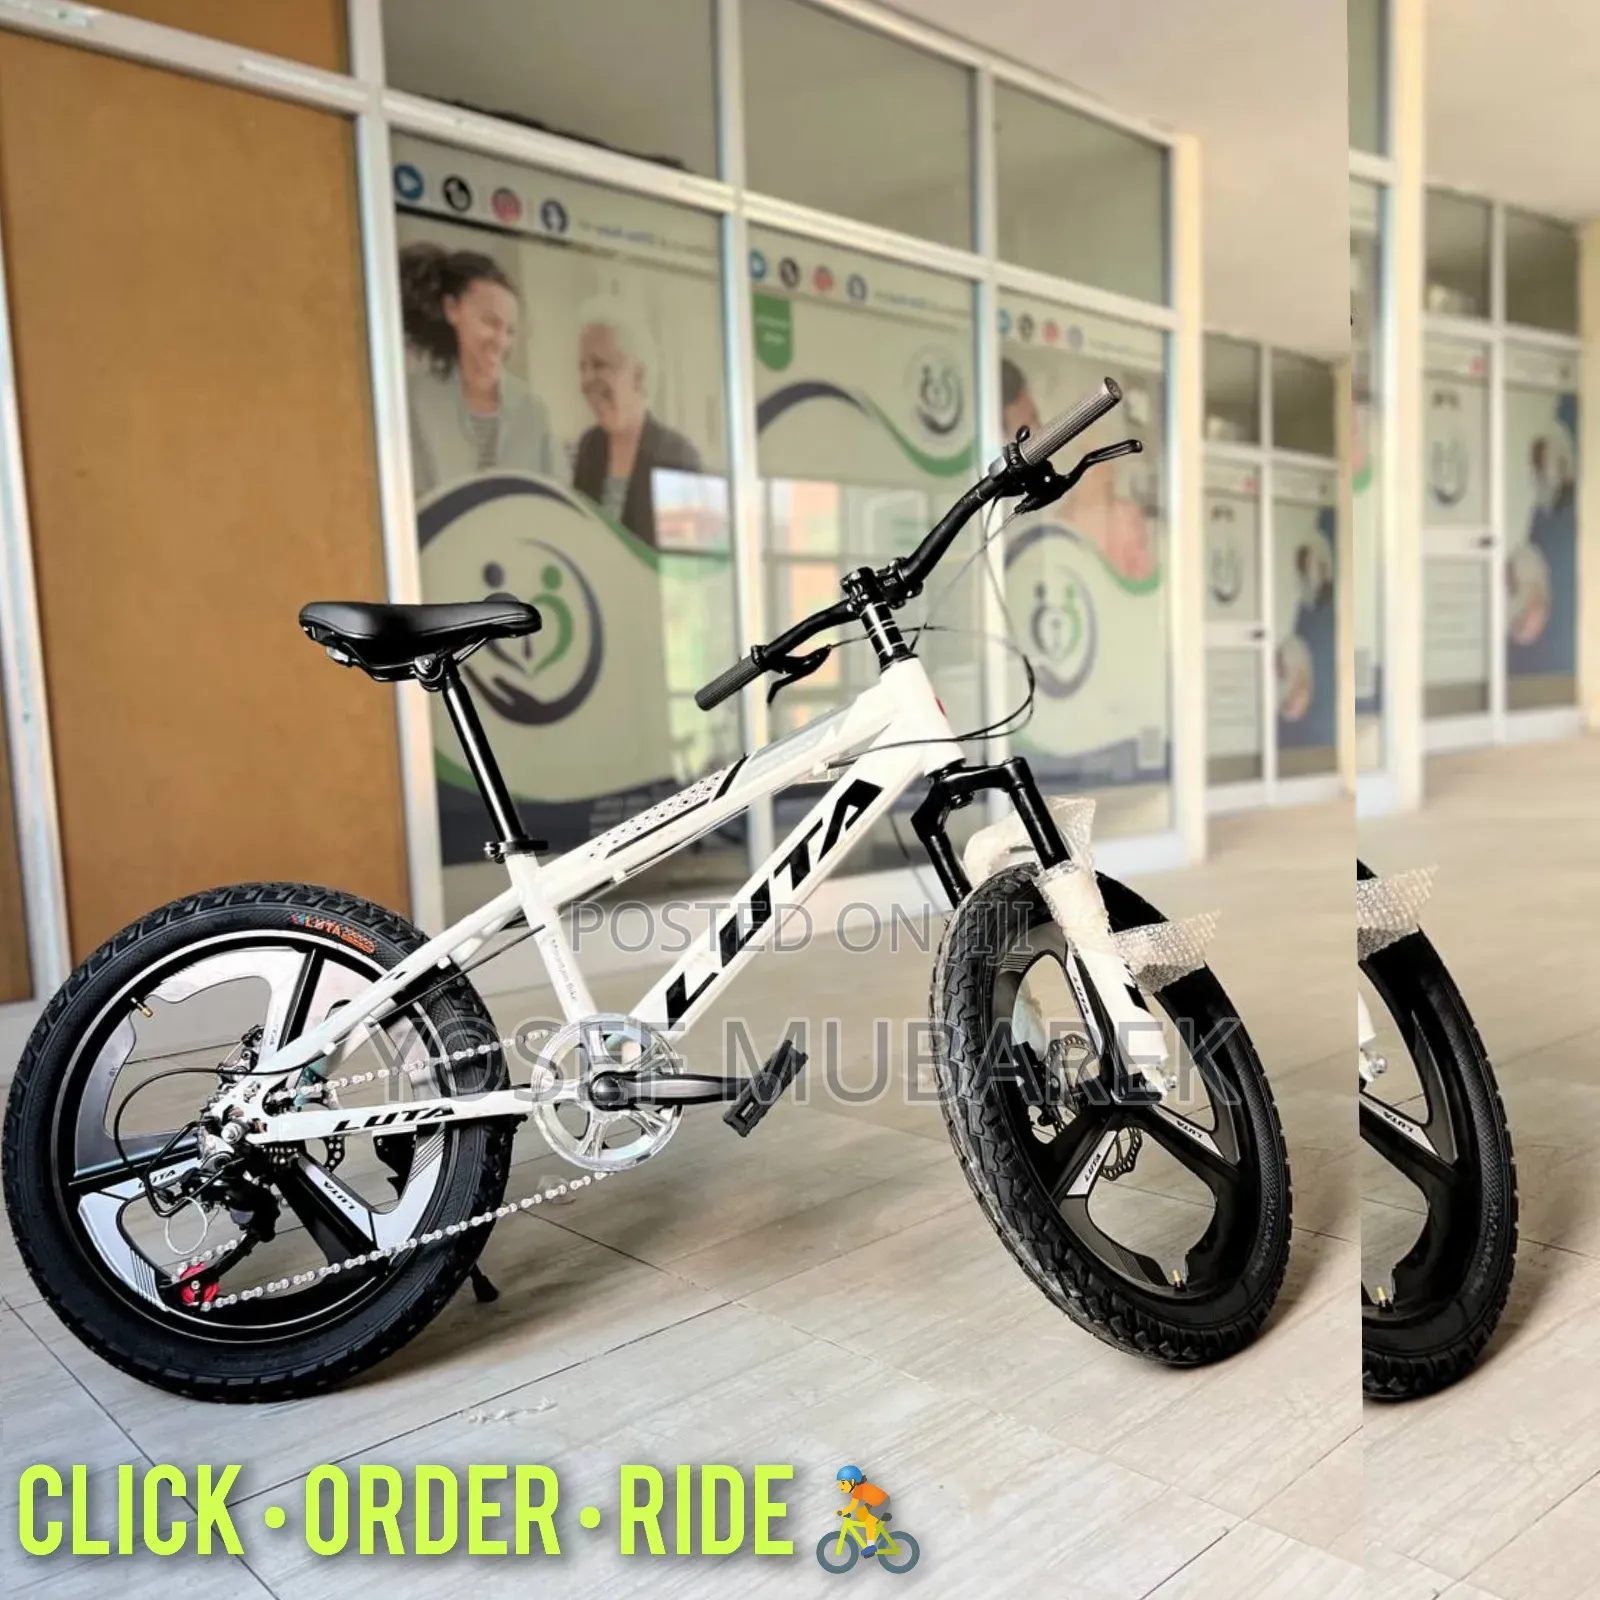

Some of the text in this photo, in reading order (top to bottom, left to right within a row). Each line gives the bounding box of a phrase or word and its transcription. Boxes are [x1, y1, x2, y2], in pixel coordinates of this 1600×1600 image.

[666, 779, 884, 1030] LUTA
[332, 1104, 455, 1133] LUTA
[1083, 1152, 1102, 1182] LUTA
[323, 1180, 356, 1210] LUTA
